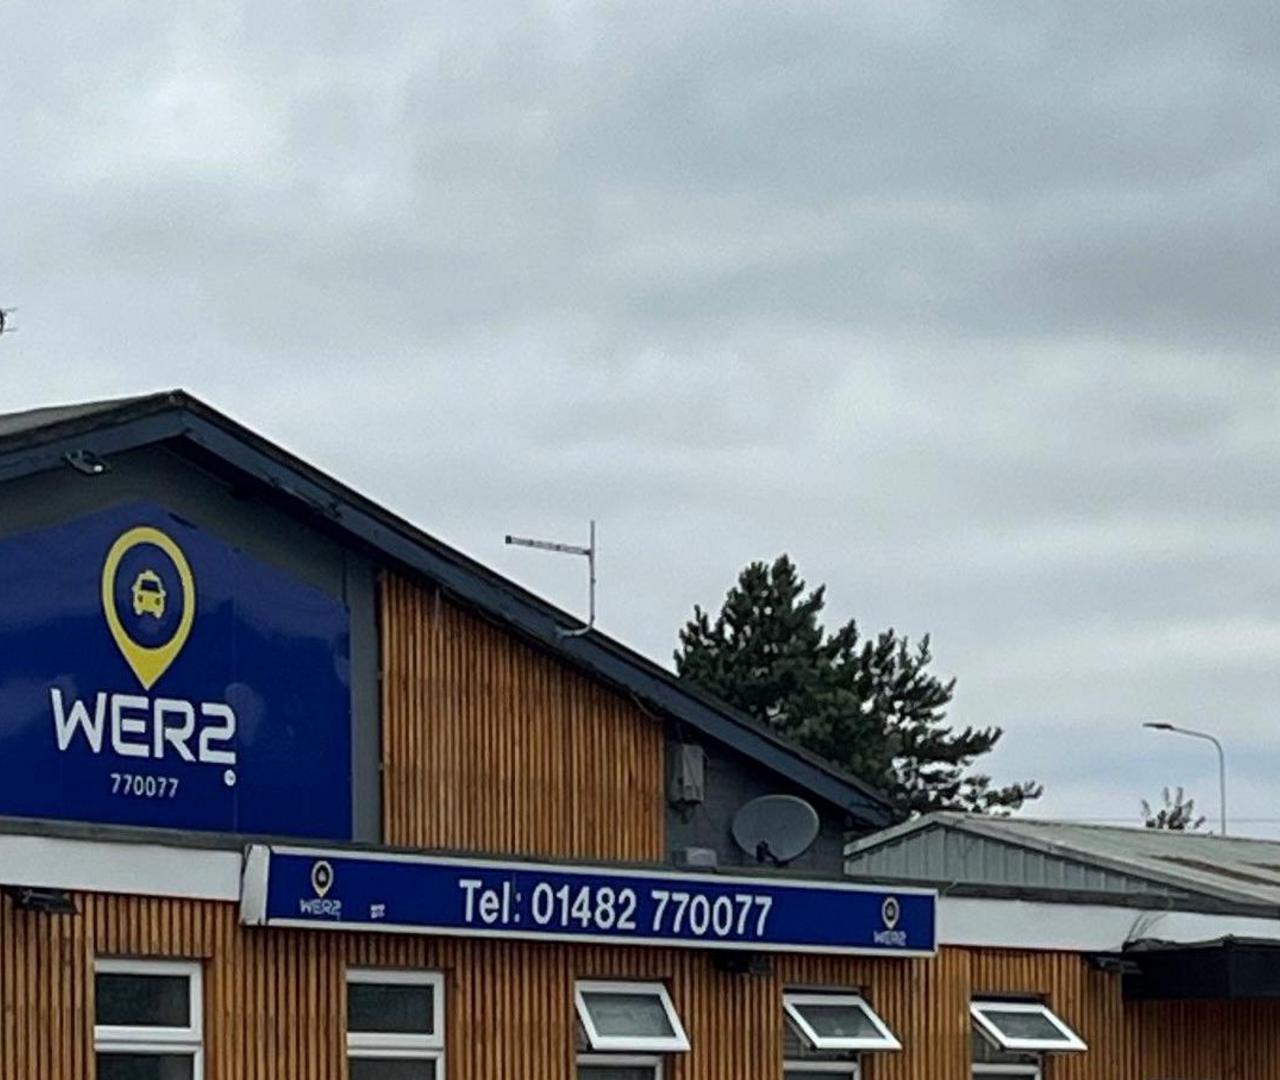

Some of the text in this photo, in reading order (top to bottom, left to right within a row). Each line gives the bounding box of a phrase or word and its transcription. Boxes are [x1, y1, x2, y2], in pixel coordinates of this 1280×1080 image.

[50, 688, 237, 765] WER2
[110, 773, 179, 798] 770077
[300, 898, 342, 915] WER2
[459, 879, 773, 936] Tel: 01482 770077
